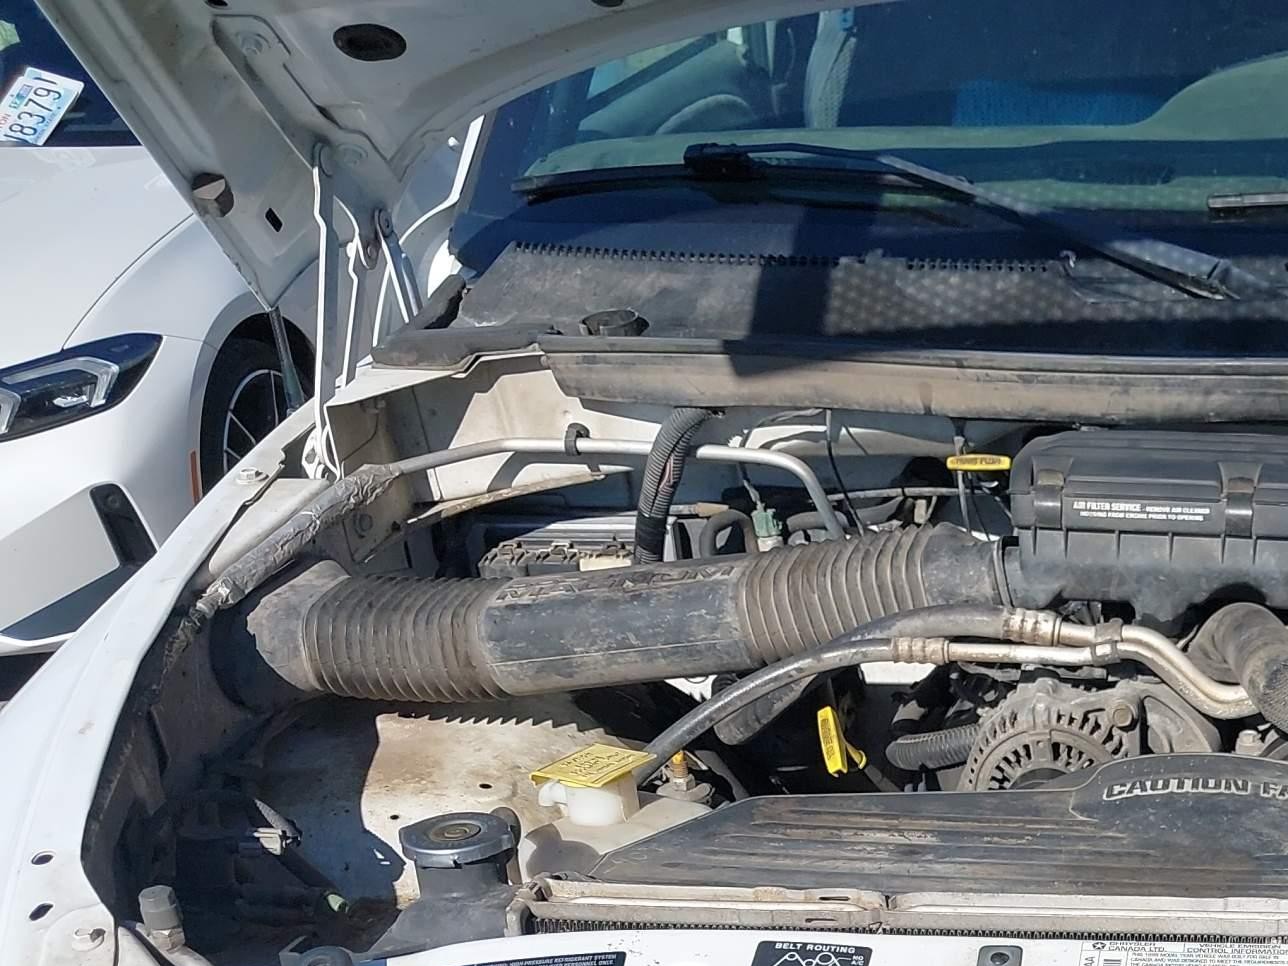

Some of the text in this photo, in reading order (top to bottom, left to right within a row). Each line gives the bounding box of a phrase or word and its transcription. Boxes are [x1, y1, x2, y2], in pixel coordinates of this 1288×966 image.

[3, 87, 62, 144] 8379
[1087, 502, 1110, 510] FILTER
[1111, 503, 1141, 511] SERVICE
[1103, 777, 1251, 800] CAUTION
[806, 944, 855, 953] ROUTING
